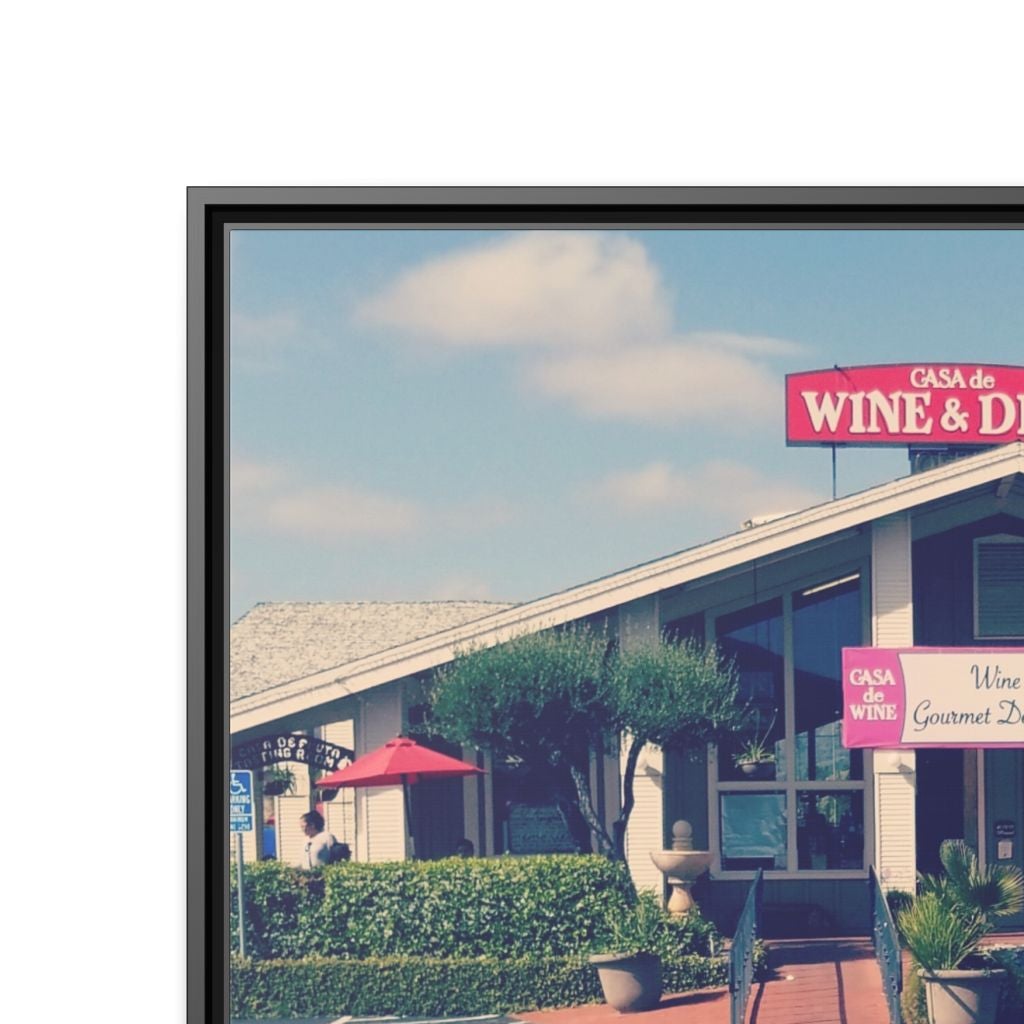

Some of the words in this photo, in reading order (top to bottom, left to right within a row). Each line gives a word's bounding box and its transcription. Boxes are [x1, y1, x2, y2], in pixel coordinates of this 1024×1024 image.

[910, 368, 967, 389] CASA
[969, 368, 996, 389] de
[801, 390, 934, 434] WINE
[940, 398, 969, 433] &
[849, 668, 896, 686] CASA
[970, 664, 1021, 690] Wine
[863, 687, 885, 703] de
[849, 704, 898, 721] WINE
[913, 699, 992, 732] Gourmet
[298, 738, 341, 759] FUTA
